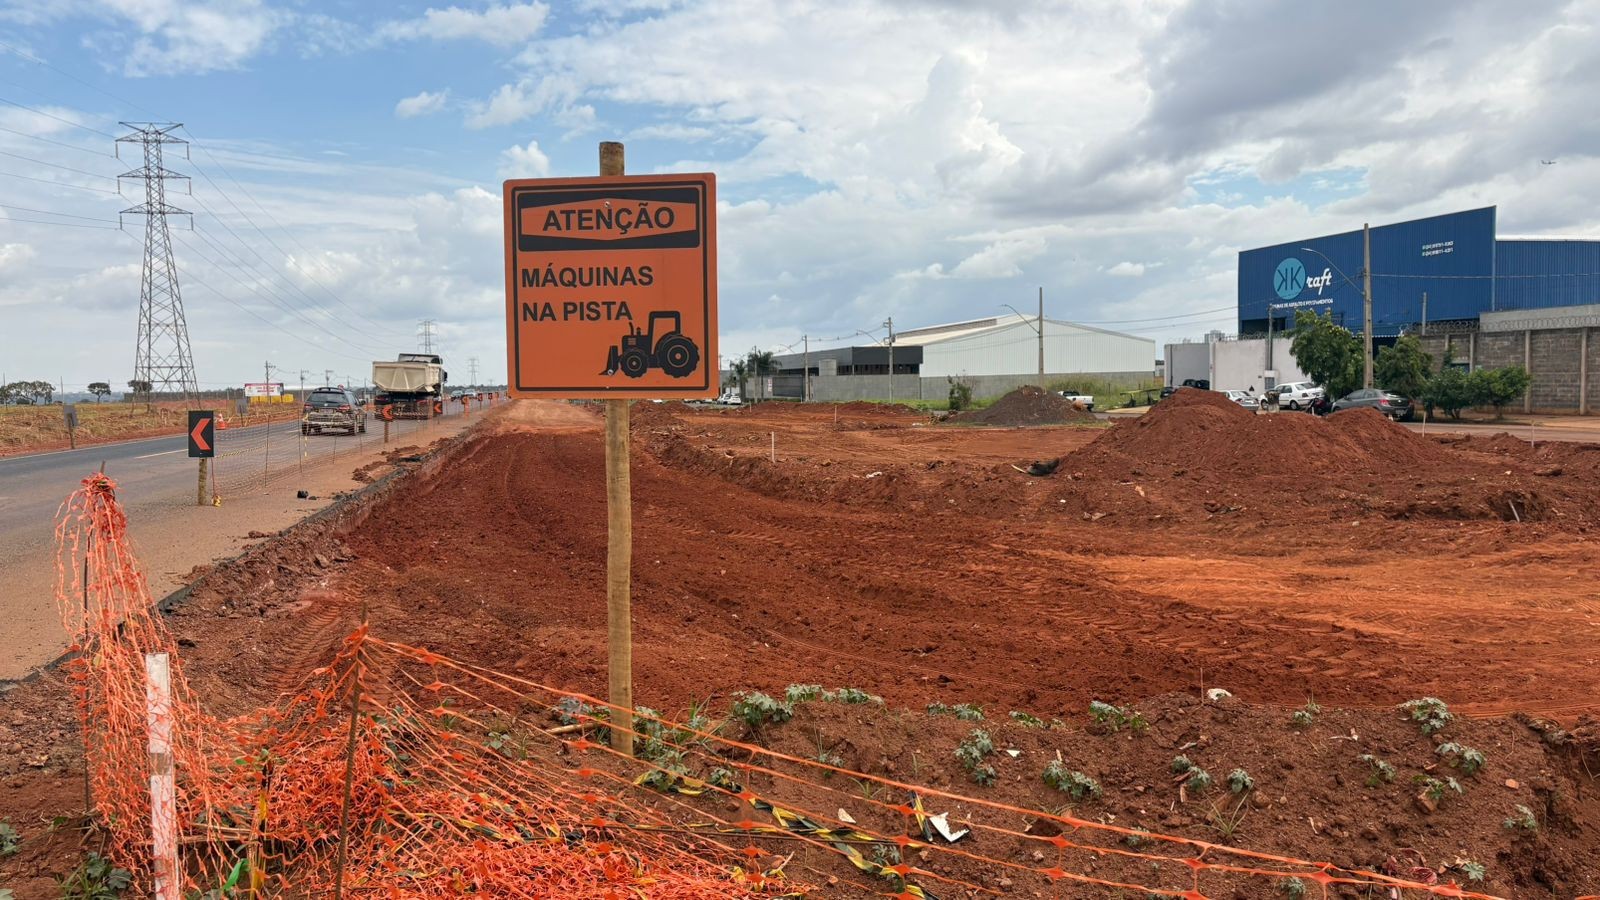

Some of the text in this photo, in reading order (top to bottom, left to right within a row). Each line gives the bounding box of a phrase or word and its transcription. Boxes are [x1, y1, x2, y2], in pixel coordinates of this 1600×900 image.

[543, 202, 675, 234] ATENÇÃO
[522, 263, 654, 288] MÁQUINAS
[522, 301, 633, 322] NA PISTA
